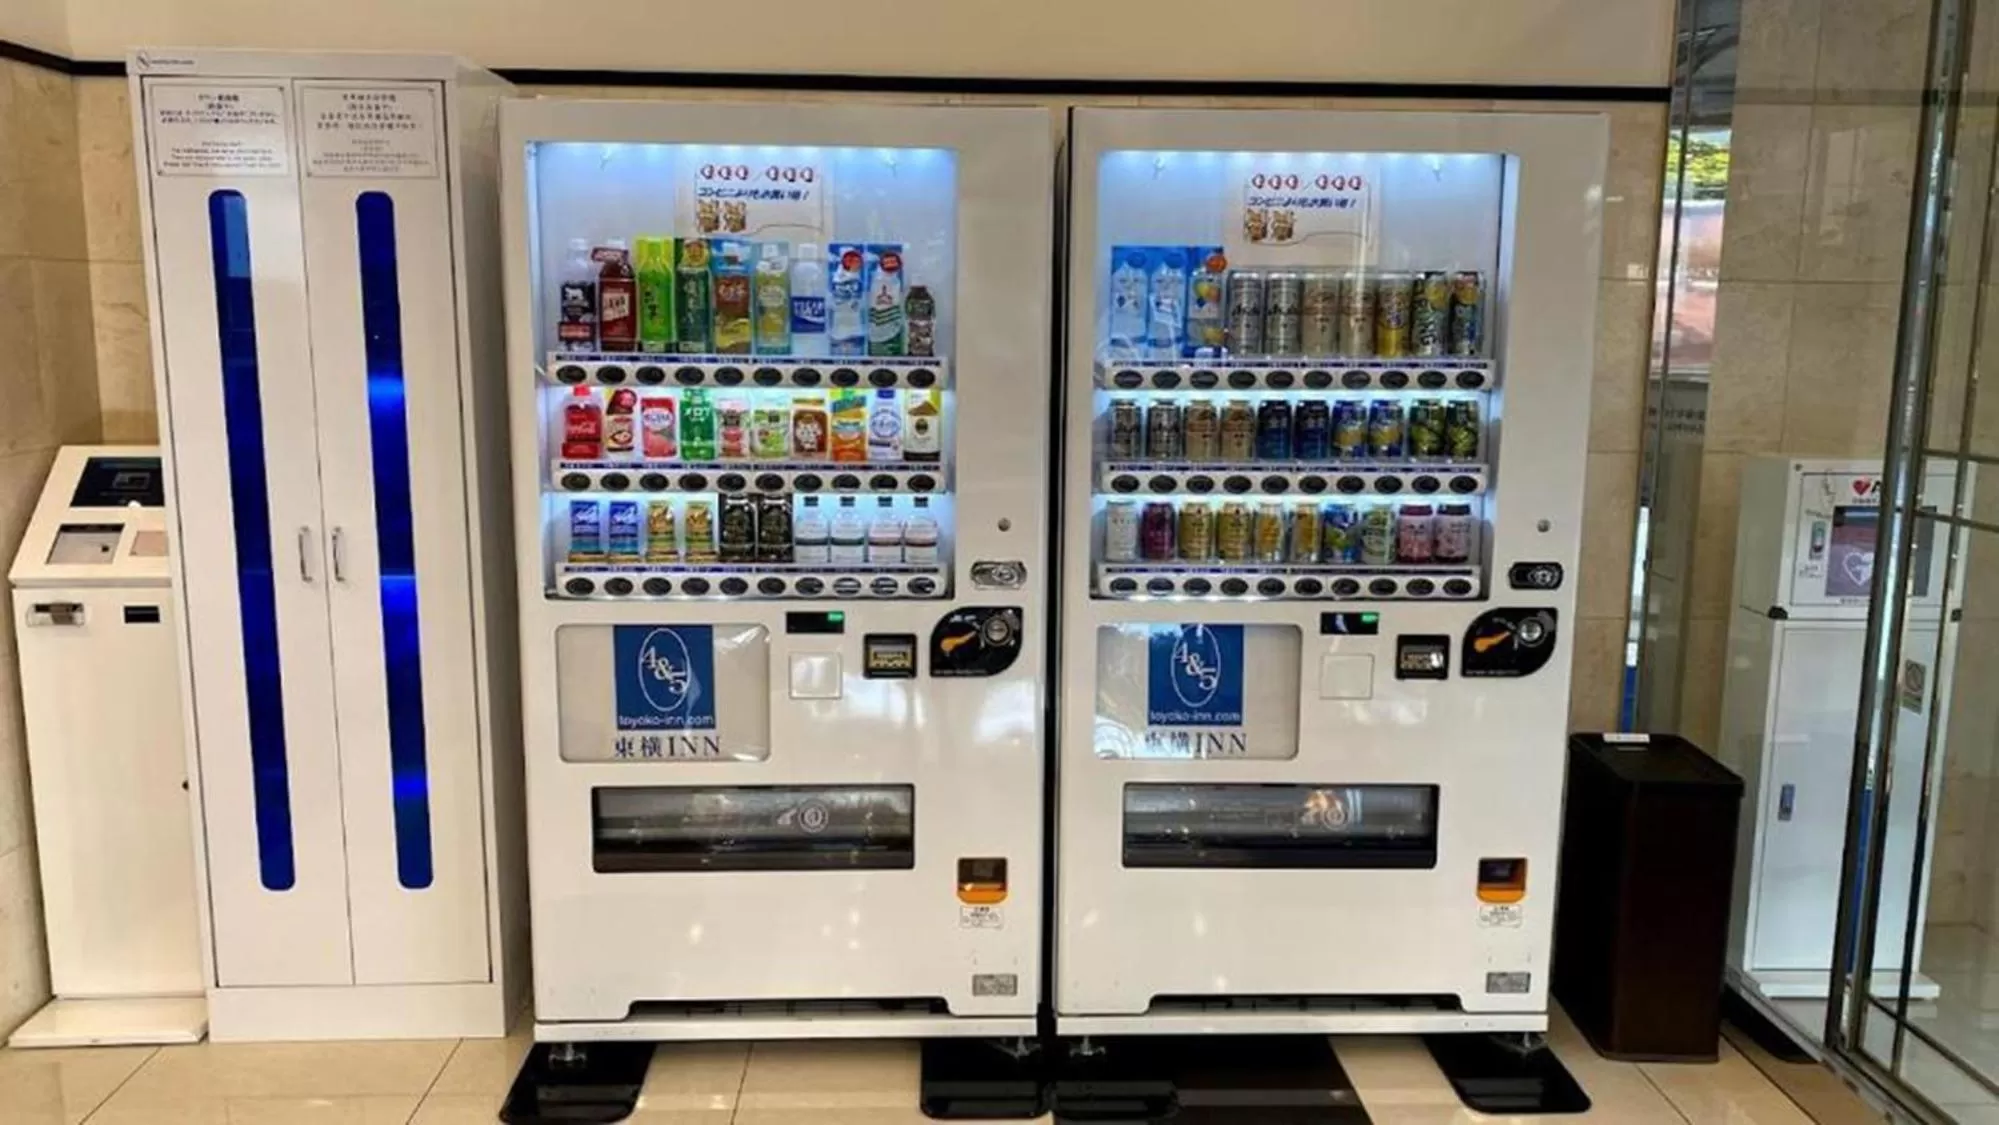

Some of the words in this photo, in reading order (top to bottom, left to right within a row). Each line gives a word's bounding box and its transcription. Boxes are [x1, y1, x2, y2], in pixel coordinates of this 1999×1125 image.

[619, 714, 714, 728] toyoko-inn.com
[1150, 711, 1241, 723] toyoko-inn.com
[615, 735, 720, 758] 東横INN
